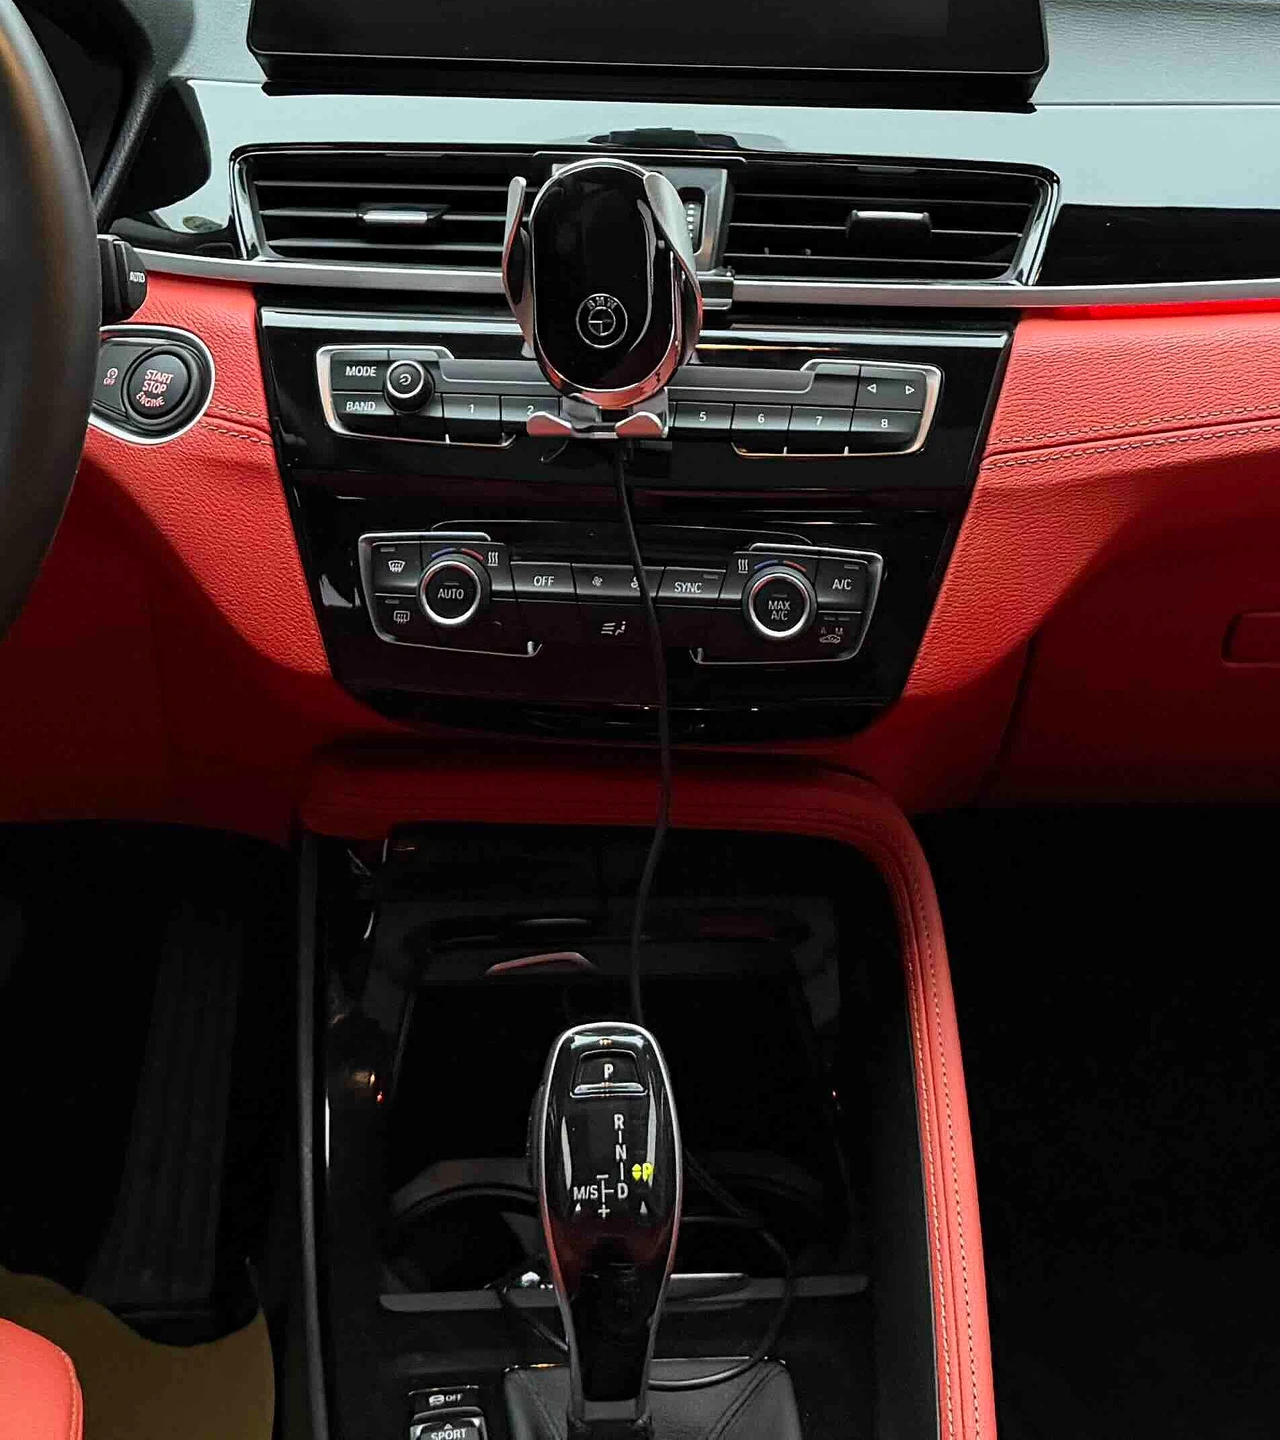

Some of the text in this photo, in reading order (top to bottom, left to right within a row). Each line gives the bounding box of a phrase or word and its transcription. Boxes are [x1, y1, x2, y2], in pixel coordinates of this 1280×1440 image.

[128, 270, 146, 284] AUTO
[144, 369, 174, 385] START
[344, 365, 378, 378] MODE
[142, 380, 168, 395] STOP
[135, 391, 166, 408] ENGINE
[345, 400, 377, 412] BAND
[698, 411, 707, 422] 5
[757, 413, 766, 424] 6
[815, 415, 823, 426] 7
[880, 418, 889, 429] 8
[533, 575, 555, 588] OFF
[674, 581, 703, 594] SYNC
[831, 578, 853, 590] A/C
[437, 588, 465, 599] AUTO
[768, 600, 791, 611] MAX
[770, 610, 789, 621] A/C
[603, 1063, 614, 1079] P
[613, 1113, 625, 1130] R
[615, 1144, 628, 1161] N
[642, 1162, 655, 1183] P
[573, 1182, 629, 1201] M/S D
[431, 1428, 467, 1440] SPORT
